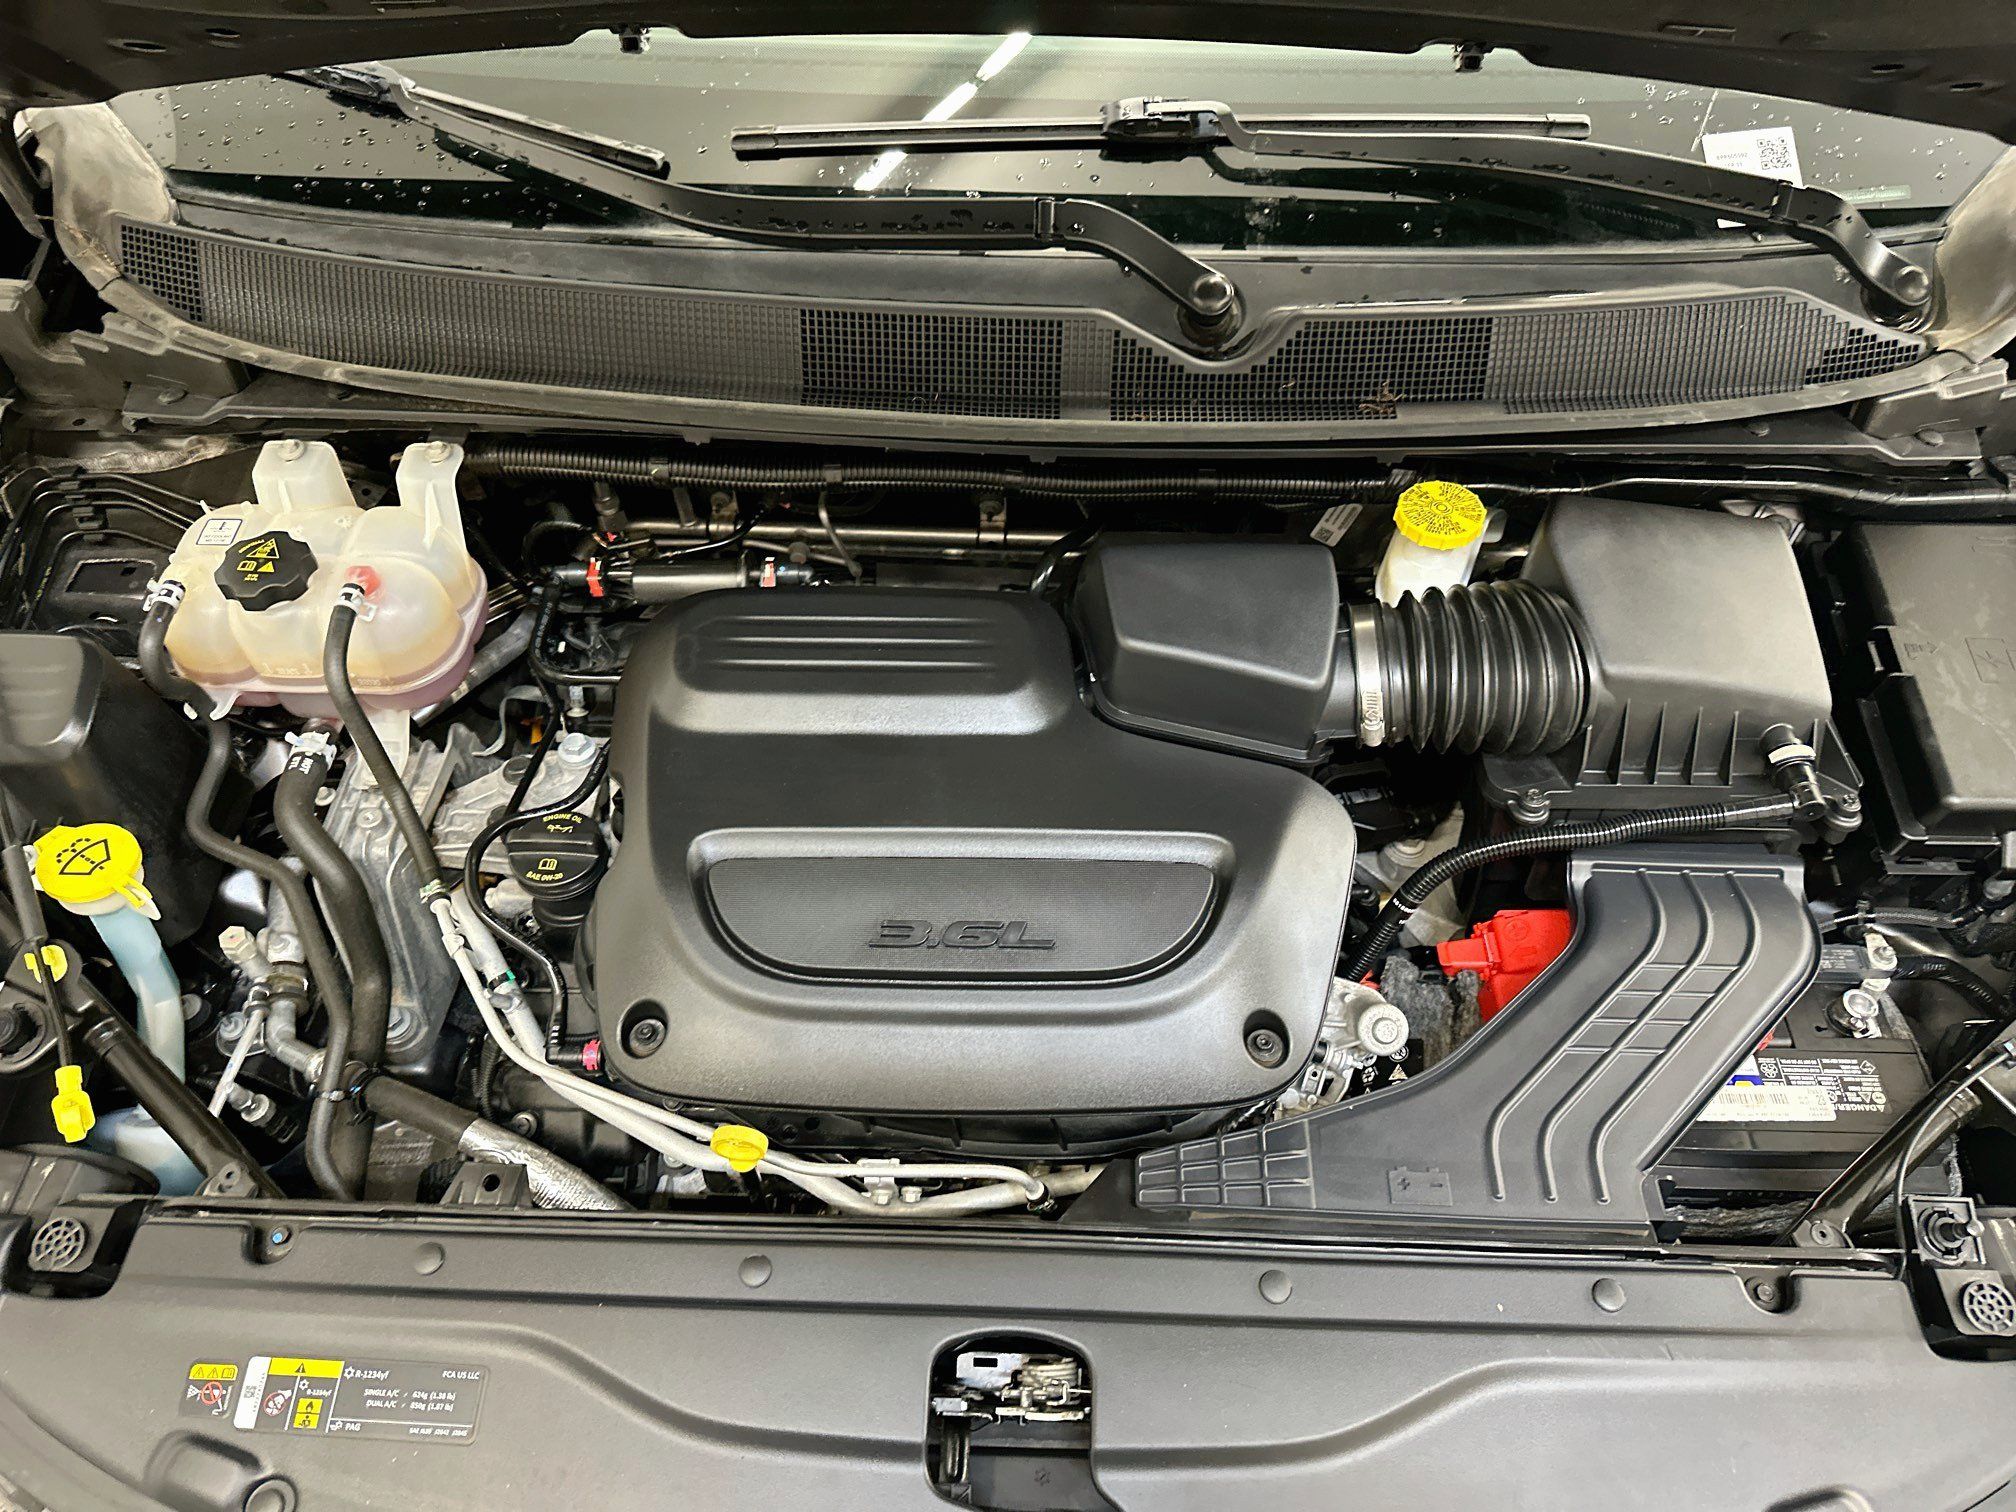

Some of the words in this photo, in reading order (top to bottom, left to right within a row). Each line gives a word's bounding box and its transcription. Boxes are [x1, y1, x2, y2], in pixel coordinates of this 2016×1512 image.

[543, 813, 571, 823] ENGINE
[572, 815, 583, 824] OIL
[525, 870, 541, 881] SAE
[868, 919, 1056, 950] 3.6L
[355, 1369, 390, 1381] R-1234yf
[442, 1370, 456, 1379] FCA
[457, 1371, 467, 1380] US
[467, 1371, 480, 1380] LLC
[364, 1388, 386, 1397] SINGLE
[386, 1389, 400, 1398] A/C
[366, 1400, 383, 1408] DUAL
[384, 1400, 397, 1409] A/C
[345, 1423, 361, 1431] PAG
